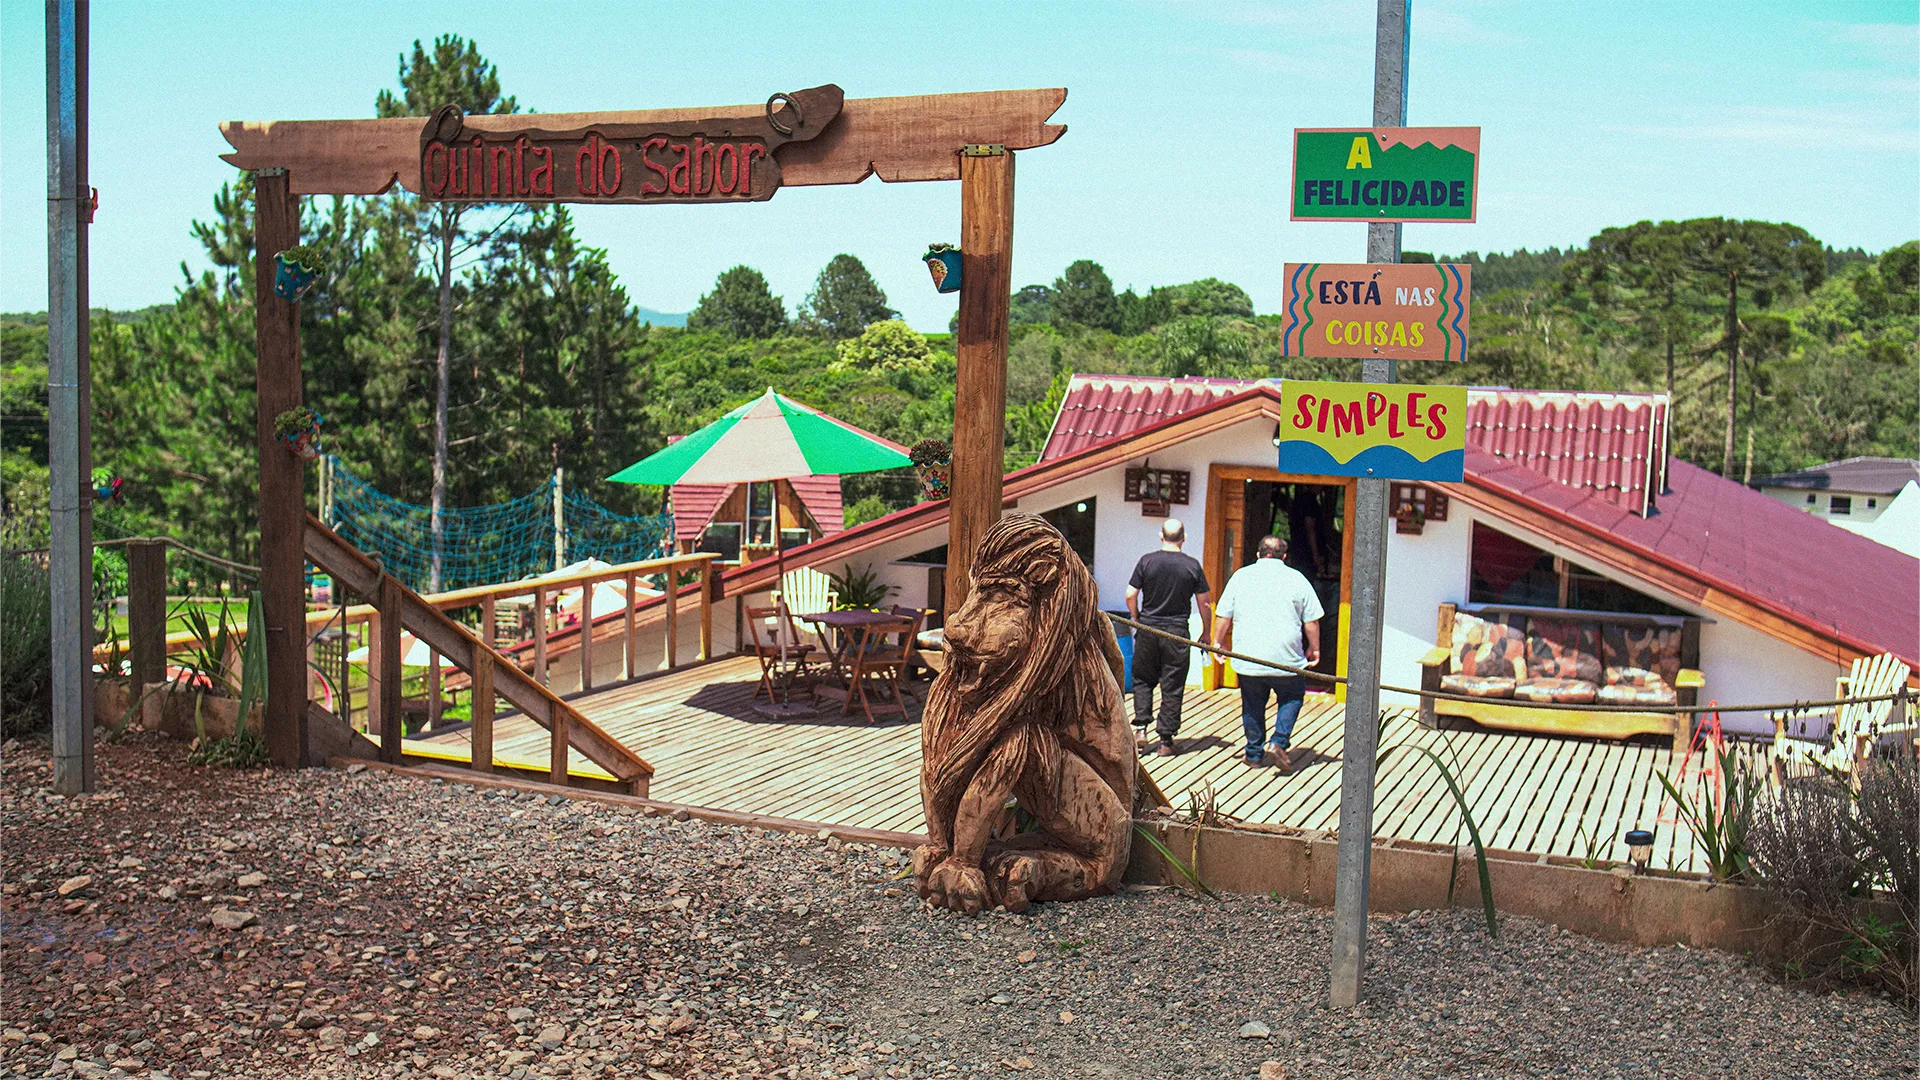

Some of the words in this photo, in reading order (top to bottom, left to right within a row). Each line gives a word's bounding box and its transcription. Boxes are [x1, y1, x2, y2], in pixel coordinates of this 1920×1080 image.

[425, 138, 555, 196] Quinta
[575, 136, 621, 196] do
[641, 137, 766, 196] Sabor
[1346, 136, 1373, 170] A
[1304, 180, 1465, 207] FELICIDADE
[1319, 273, 1382, 306] ESTÁ
[1395, 287, 1435, 307] NAS
[1325, 320, 1424, 347] COISAS
[1292, 391, 1447, 440] SIMPLES
